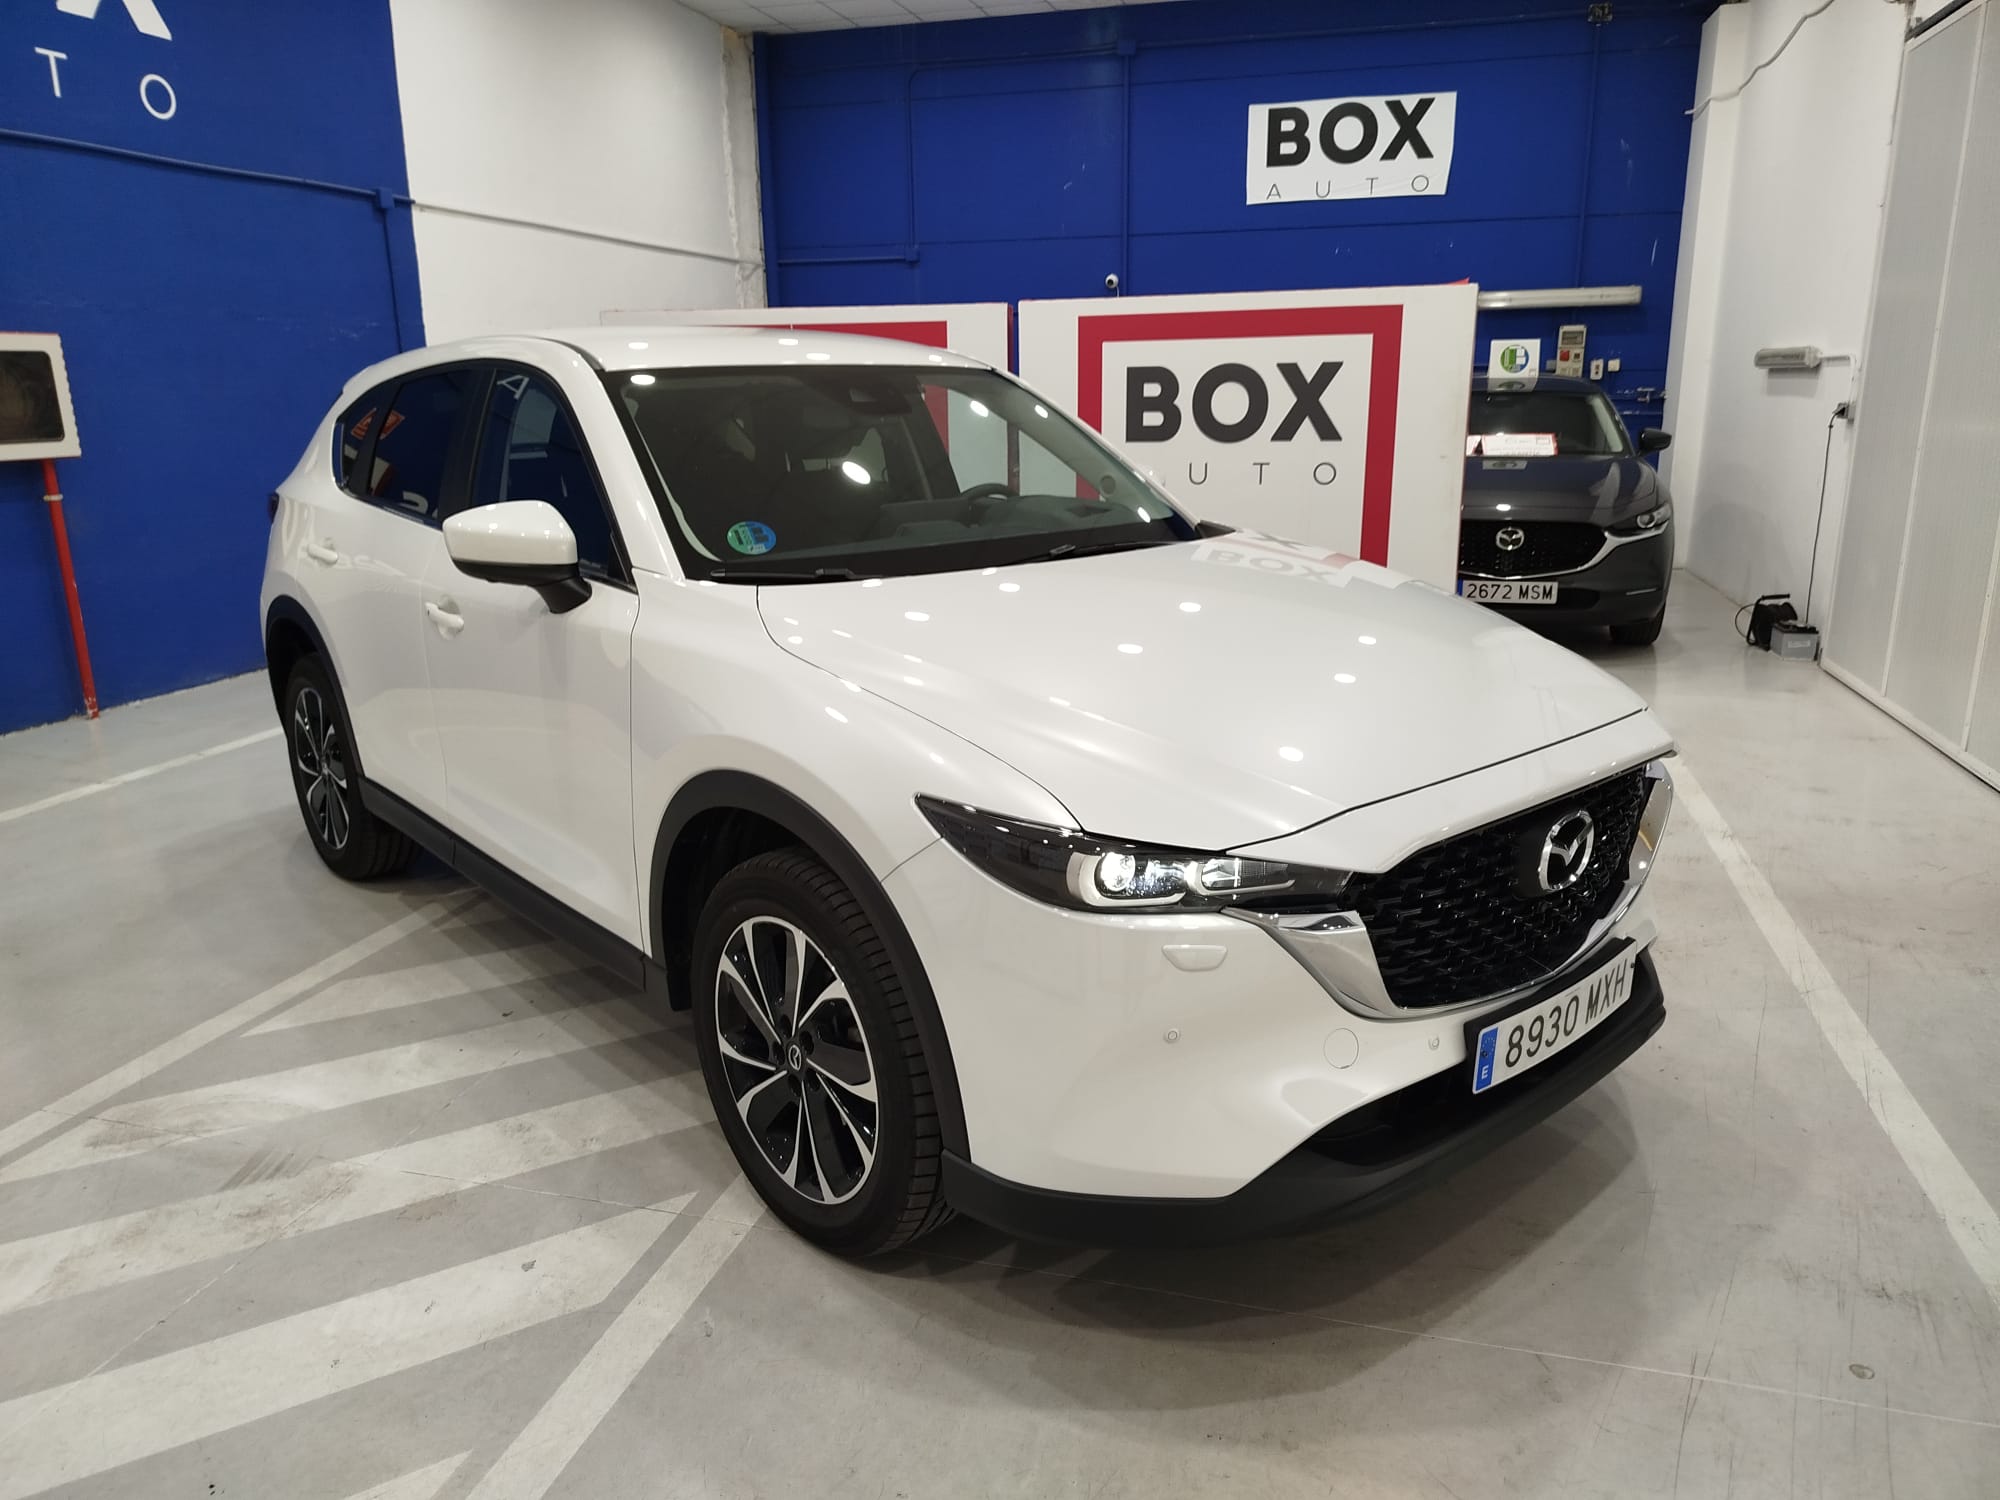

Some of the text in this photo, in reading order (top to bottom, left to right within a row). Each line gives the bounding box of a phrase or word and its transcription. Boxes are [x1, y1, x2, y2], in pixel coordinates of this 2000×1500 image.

[1266, 97, 1436, 168] BOX
[1266, 175, 1430, 200] AUTO
[1125, 361, 1344, 443] BOX
[1188, 461, 1337, 486] UTO
[1467, 583, 1553, 600] 2672 MSM
[1505, 958, 1627, 1068] 8930 MXH
[1481, 1064, 1489, 1079] E
